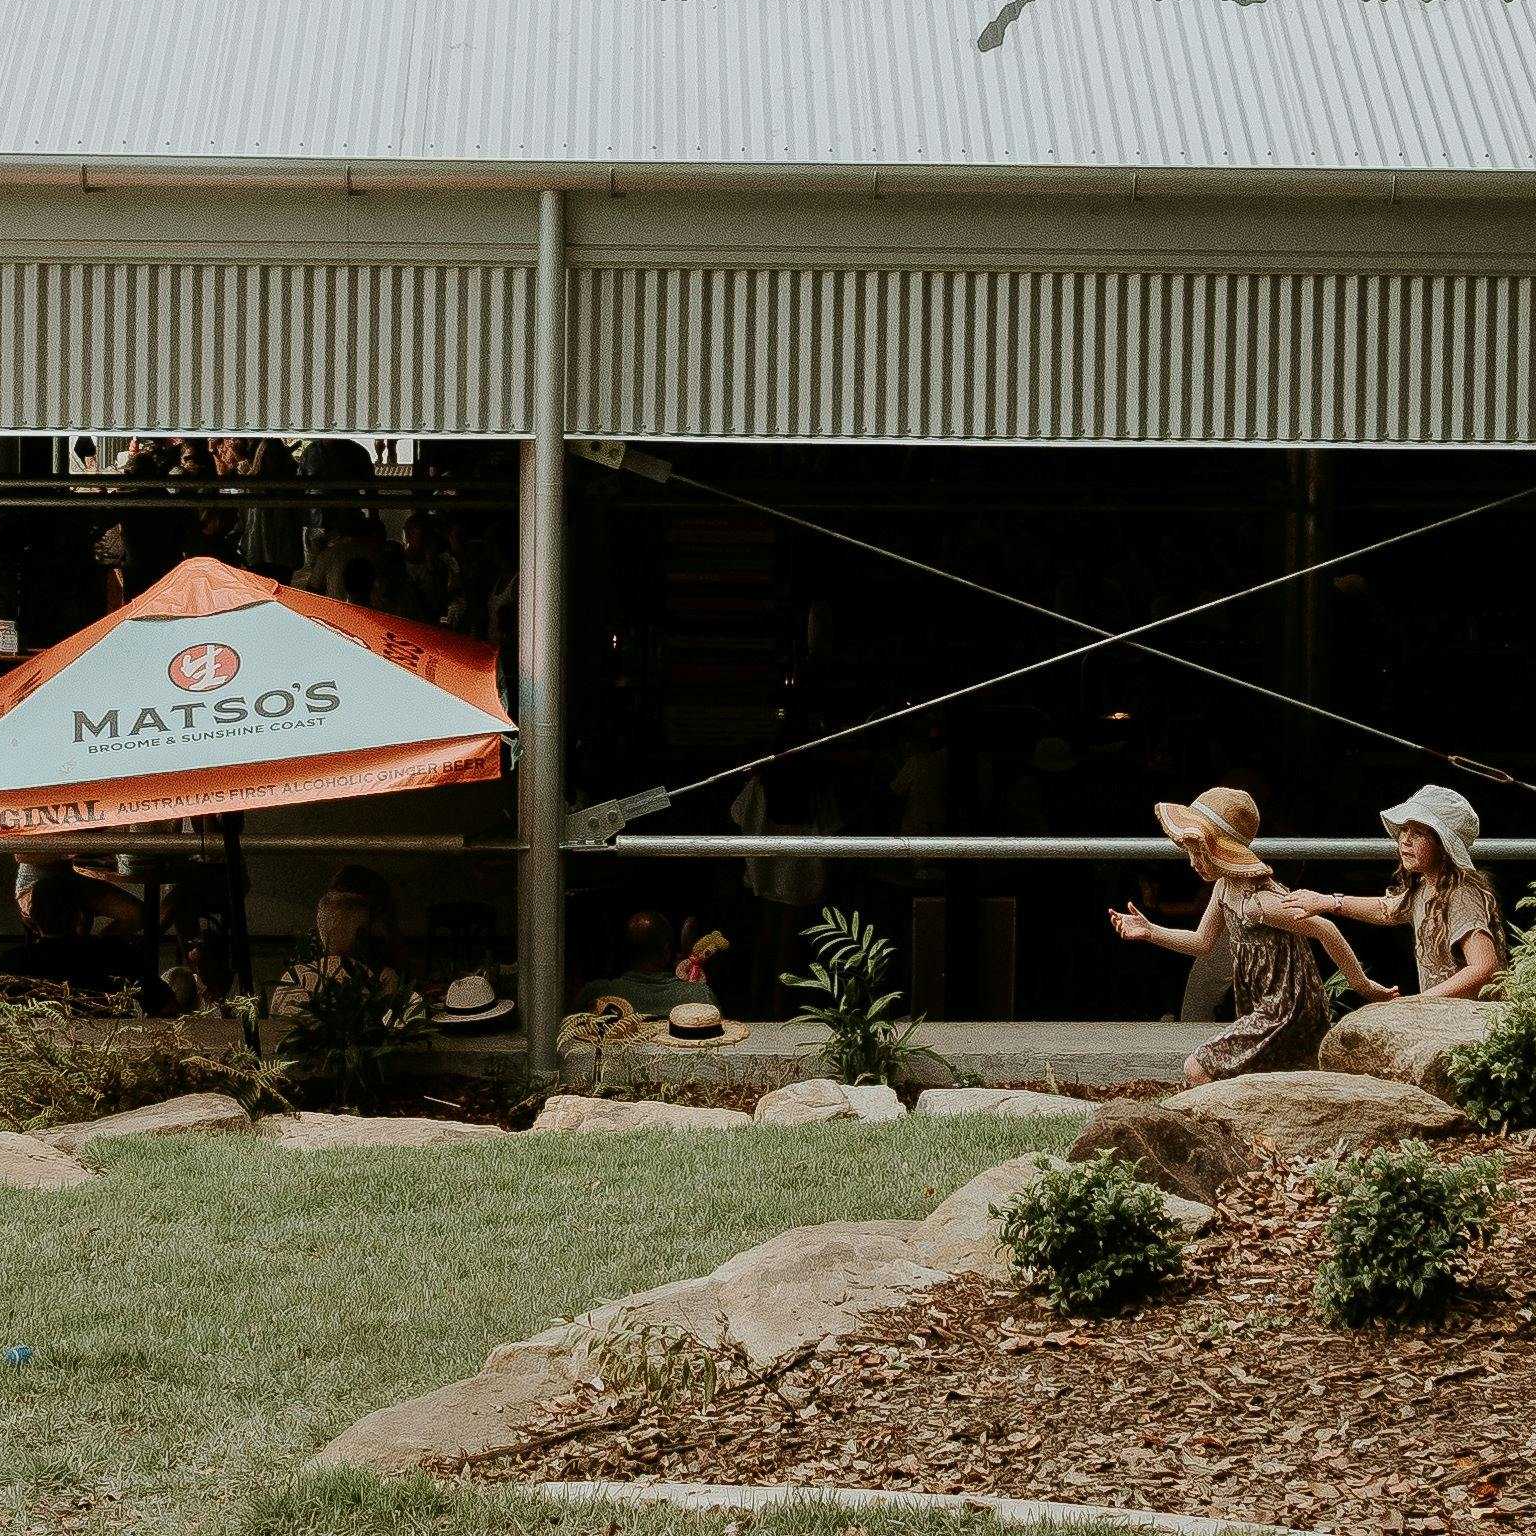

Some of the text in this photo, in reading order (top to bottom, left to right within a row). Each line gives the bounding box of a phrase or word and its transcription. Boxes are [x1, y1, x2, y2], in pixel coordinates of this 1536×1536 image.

[72, 680, 341, 743] MATSO'S
[88, 717, 328, 754] BROOME & SUNSHINE COAST
[117, 789, 225, 815] AUSTRALIA'S
[229, 784, 276, 802] FIRST
[281, 772, 374, 796] ALCOHOLIC
[376, 762, 438, 782] GINGER
[442, 757, 487, 774] BEER
